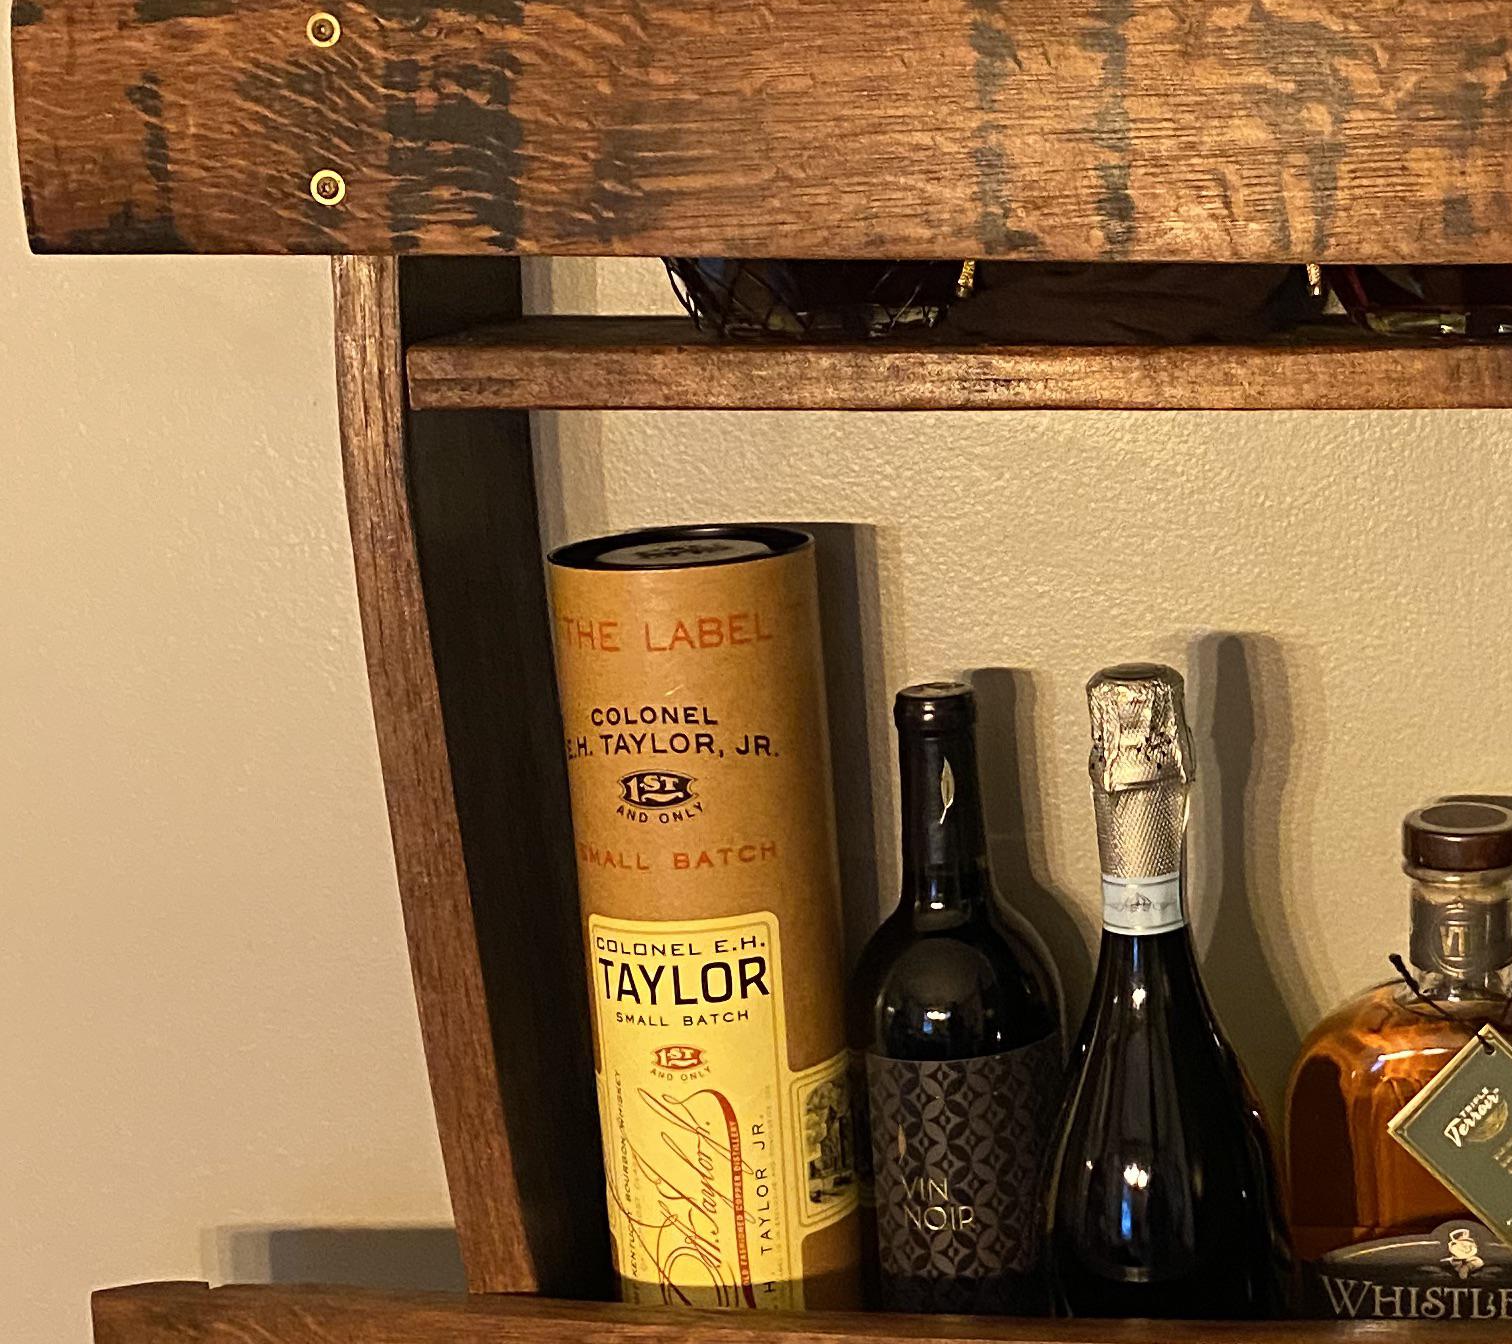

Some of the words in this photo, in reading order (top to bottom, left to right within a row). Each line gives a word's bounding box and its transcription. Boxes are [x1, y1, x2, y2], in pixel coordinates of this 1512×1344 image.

[562, 615, 621, 653] THE
[645, 612, 774, 653] LABEL
[590, 706, 719, 727] COLONEL
[599, 732, 725, 759] TAYLOR,
[735, 734, 780, 758] JR.
[628, 774, 681, 803] 1ST
[616, 804, 649, 824] AND
[658, 802, 704, 825] ONLY
[579, 843, 650, 871] SMALL
[672, 840, 778, 871] BATCH
[596, 936, 703, 957] COLONEL
[714, 934, 767, 955] E.H.
[598, 955, 771, 1007] TAYLOR
[615, 1010, 669, 1028] SMALL
[682, 1009, 750, 1028] BATCH
[656, 1047, 696, 1067] 1ST
[649, 1067, 674, 1082] AND
[680, 1065, 712, 1082] ONLY
[728, 1119, 742, 1172] DISTILLERY
[751, 1113, 766, 1151] JR.
[620, 1136, 633, 1203] BOURBON
[734, 1174, 744, 1212] COPPER
[900, 1175, 949, 1201] VIN
[754, 1166, 774, 1256] TAYLOR
[902, 1204, 977, 1232] NOIR
[737, 1214, 748, 1267] FASHIONED
[741, 1268, 750, 1287] OLD
